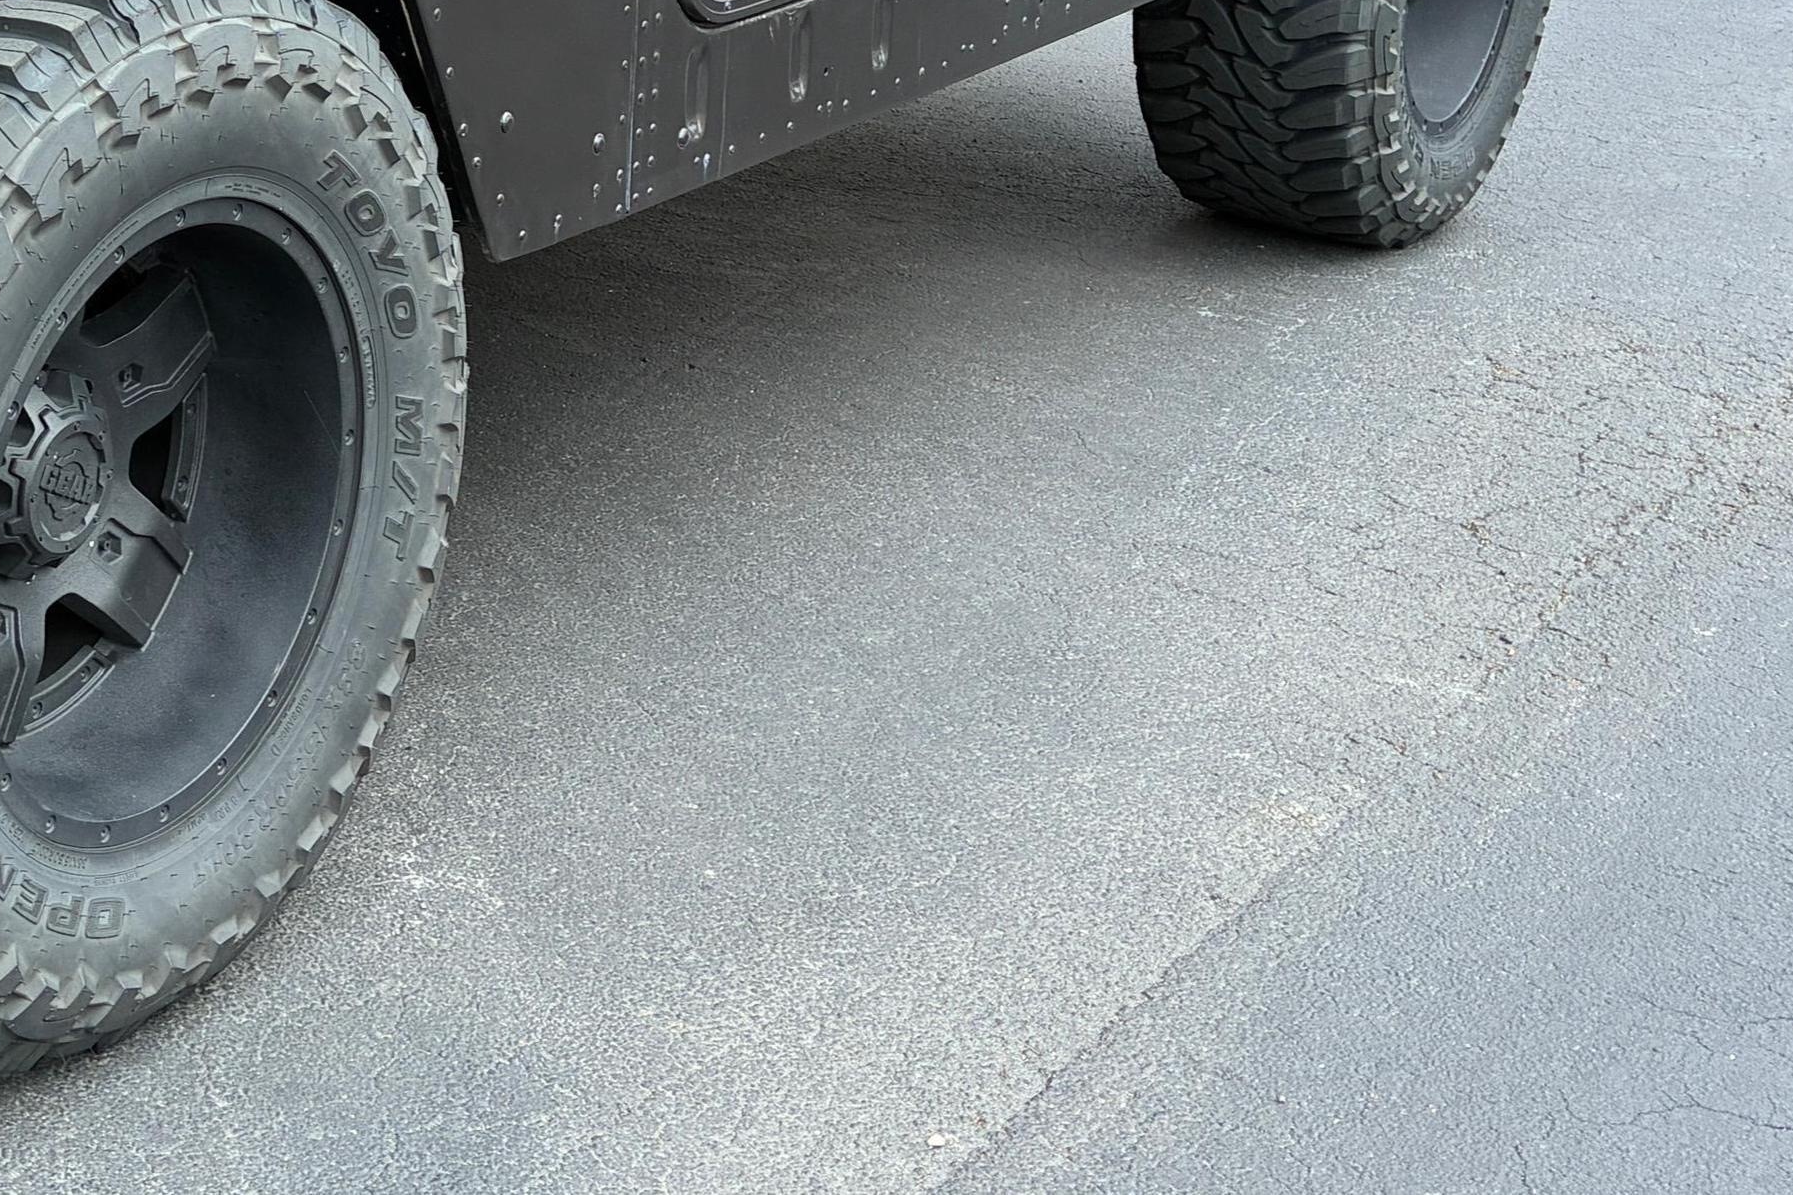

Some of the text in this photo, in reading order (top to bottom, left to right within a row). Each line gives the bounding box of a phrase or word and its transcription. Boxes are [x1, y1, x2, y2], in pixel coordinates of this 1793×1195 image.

[317, 150, 420, 338] TOYO
[382, 394, 426, 561] M/T
[39, 465, 102, 505] GEAR
